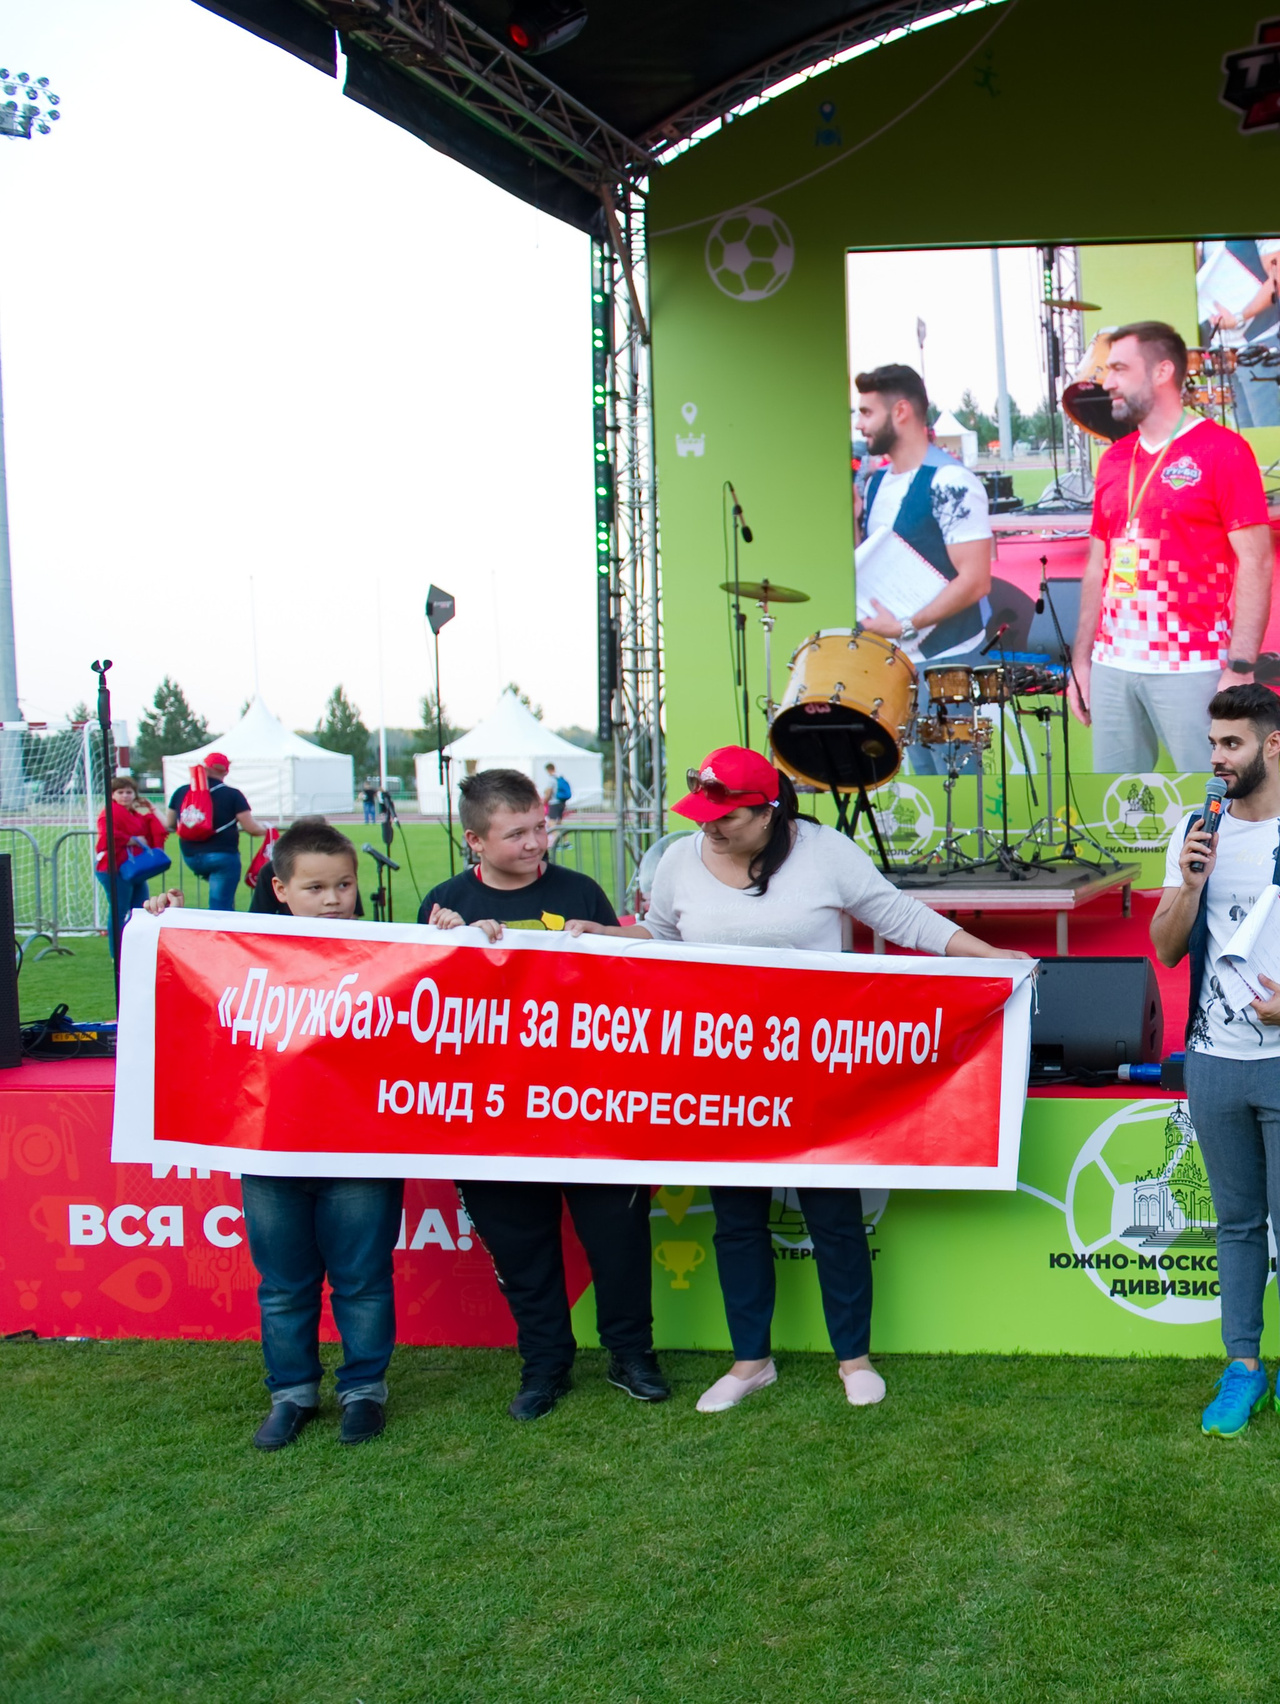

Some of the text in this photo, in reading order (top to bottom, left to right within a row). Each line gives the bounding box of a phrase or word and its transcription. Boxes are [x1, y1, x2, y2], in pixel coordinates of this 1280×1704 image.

[868, 847, 923, 856] ПООЛЬСК
[1104, 846, 1168, 854] ЕКАТЕРИНБУ
[519, 999, 558, 1048] за
[570, 1002, 652, 1054] всех
[660, 1009, 682, 1056] и
[693, 1012, 754, 1060] все
[763, 1016, 800, 1061] за
[811, 1007, 943, 1074] одного!
[377, 1079, 794, 1128] ЮМД 5 ВОСКРЕСЕНСК
[69, 1204, 185, 1248] ВСЯ
[1049, 1252, 1277, 1272] ЮЖНО-МОСКО
[1110, 1279, 1221, 1297] ДИВИЗИО
